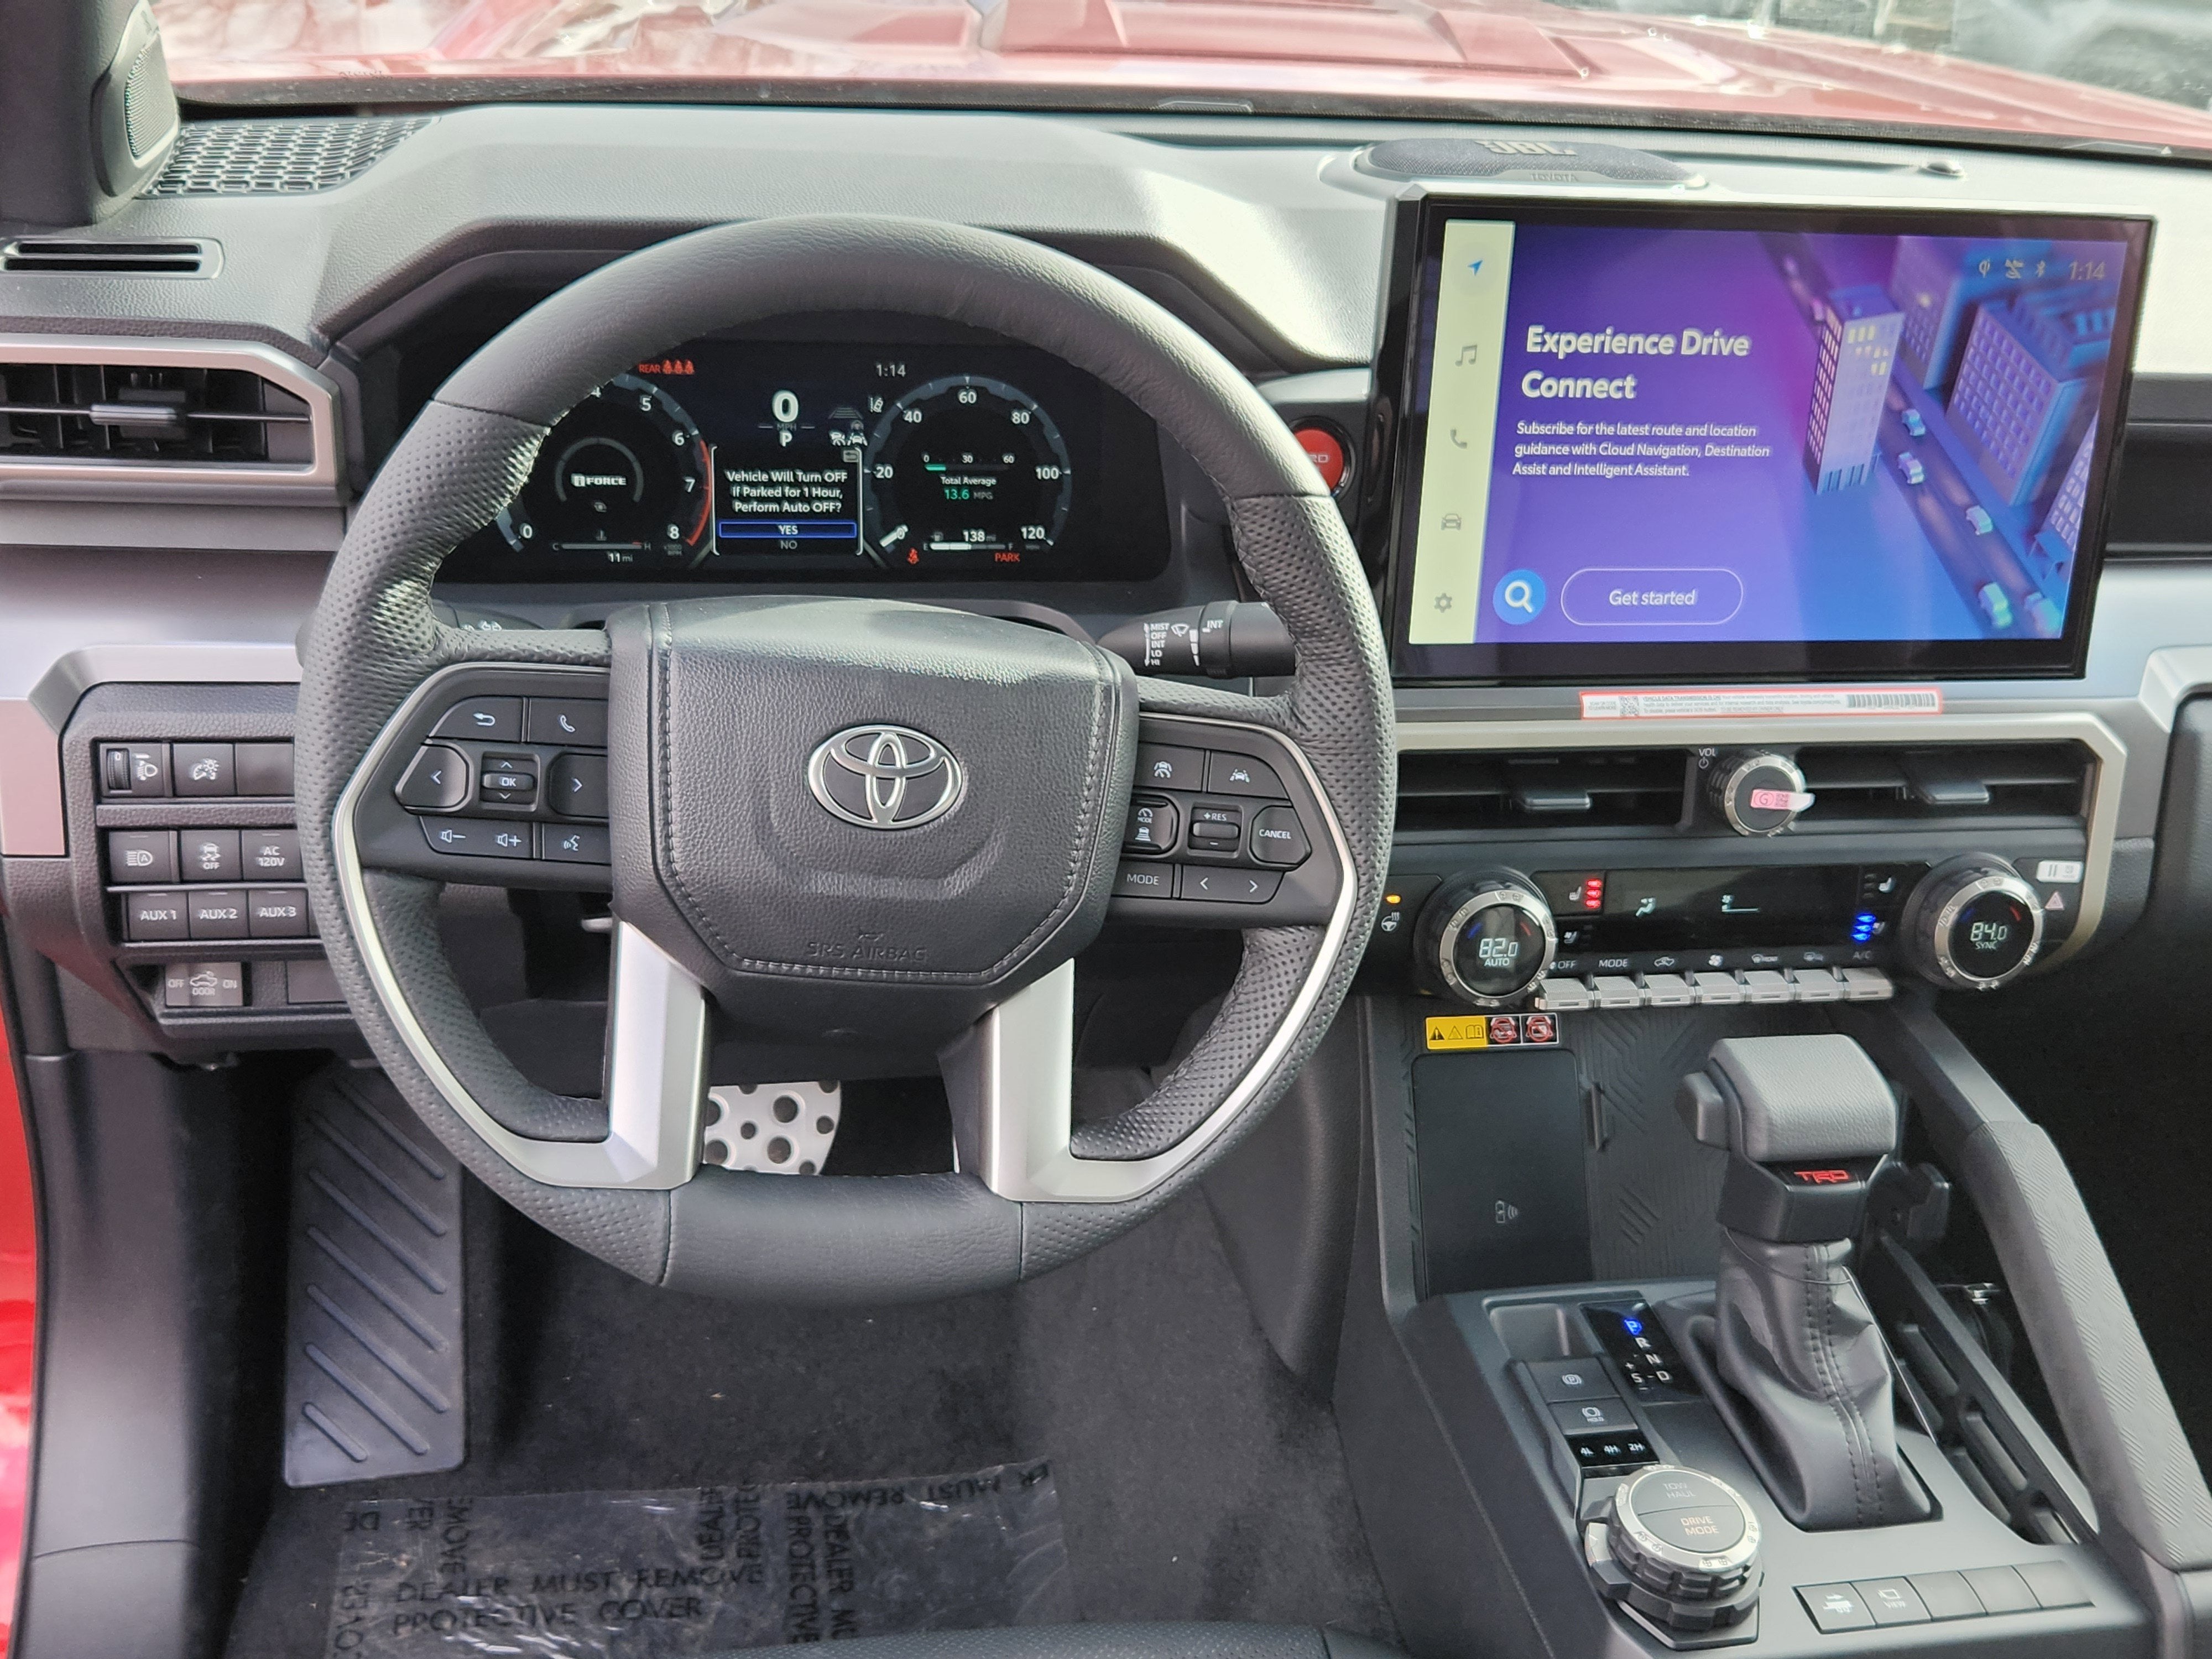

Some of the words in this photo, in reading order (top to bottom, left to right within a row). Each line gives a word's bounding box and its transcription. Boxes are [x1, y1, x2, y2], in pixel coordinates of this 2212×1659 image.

[2069, 262, 2106, 280] 1:14
[1526, 325, 1674, 359] Experience
[1681, 328, 1752, 357] Drive
[639, 364, 661, 373] REAR
[876, 364, 906, 377] 1:14
[1521, 370, 1636, 399] Connect
[640, 395, 651, 411] 5
[958, 390, 977, 404] 60
[772, 390, 799, 422] 0
[904, 410, 922, 423] 40
[1011, 411, 1030, 424] 80
[1517, 422, 1574, 435] Subscribe
[1576, 422, 1594, 435] for
[1595, 422, 1614, 435] the
[1616, 423, 1650, 436] latest
[1651, 425, 1682, 436] route
[1684, 424, 1707, 436] and
[1709, 424, 1756, 437] location
[673, 432, 685, 446] 6
[780, 431, 792, 447] P
[1514, 443, 1569, 458] guidance
[1571, 443, 1597, 456] with
[1599, 443, 1634, 457] Cloud
[1636, 444, 1702, 458] Navigation,
[1704, 445, 1770, 458] Destination
[923, 455, 930, 463] 0
[962, 455, 973, 463] 30
[1003, 455, 1015, 463] 60
[1309, 454, 1329, 463] RD
[725, 470, 768, 482] Vehicle
[770, 470, 794, 482] Will
[795, 471, 822, 482] Turn
[823, 471, 848, 483] OFF
[875, 466, 893, 479] 20
[1036, 467, 1060, 479] 100
[1512, 463, 1547, 476] Assist
[1548, 463, 1572, 476] and
[1574, 463, 1633, 478] Intelligent
[1634, 464, 1690, 477] Assistant.
[685, 479, 696, 492] 7
[940, 476, 961, 485] Total
[962, 476, 997, 487] Average
[742, 486, 782, 497] Parked
[784, 486, 801, 497] for
[802, 487, 809, 498] 1
[812, 486, 843, 499] Hour,
[945, 489, 969, 500] 13.6
[973, 492, 994, 500] MPG
[733, 501, 779, 513] Perform
[782, 501, 810, 513] Auto
[812, 502, 842, 513] OFF?
[521, 526, 533, 539] 0
[667, 525, 680, 539] 8
[779, 525, 798, 535] YES
[963, 530, 985, 542] 138
[1020, 526, 1045, 540] 120
[780, 541, 797, 549] NO
[608, 551, 620, 562] 11
[995, 553, 1021, 562] PARK
[1609, 589, 1638, 607] Get
[1641, 589, 1697, 606] started
[1207, 619, 1224, 629] INT
[1151, 640, 1165, 649] INT
[1698, 748, 1716, 757] VOL
[500, 777, 517, 787] OK
[1259, 828, 1292, 839] CANCEL
[263, 846, 280, 855] AC
[202, 862, 220, 870] OFF
[256, 857, 285, 867] 120V
[1126, 873, 1160, 885] MODE
[140, 910, 170, 921] AUX
[171, 910, 177, 920] 1
[199, 909, 228, 920] AUX
[229, 908, 239, 919] 2
[257, 907, 286, 918] AUX
[287, 906, 297, 917] 3
[807, 942, 845, 958] SRS
[853, 945, 927, 962] AIRBAG
[1479, 938, 1518, 958] 82.0
[1975, 941, 1999, 951] SYNC
[1852, 950, 1871, 960] A/C
[1484, 957, 1510, 967] AUTO
[1557, 960, 1577, 969] OFF
[1598, 958, 1628, 968] MODE
[168, 979, 185, 988] OFF
[222, 979, 238, 989] ON
[192, 987, 216, 995] DOOR
[1793, 1170, 1850, 1184] TRD
[1625, 1318, 1642, 1335] P
[1635, 1337, 1651, 1349] R
[1646, 1354, 1662, 1365] N
[1631, 1373, 1643, 1384] S
[1656, 1370, 1671, 1383] D
[1580, 1447, 1595, 1456] 4L
[1604, 1444, 1621, 1454] 4H
[1628, 1442, 1645, 1452] 2H
[1663, 1482, 1687, 1490] TOW
[1681, 1515, 1714, 1526] DRIVE
[1684, 1525, 1720, 1536] MODE
[531, 1569, 614, 1594] MUST
[597, 1595, 702, 1623] COVER
